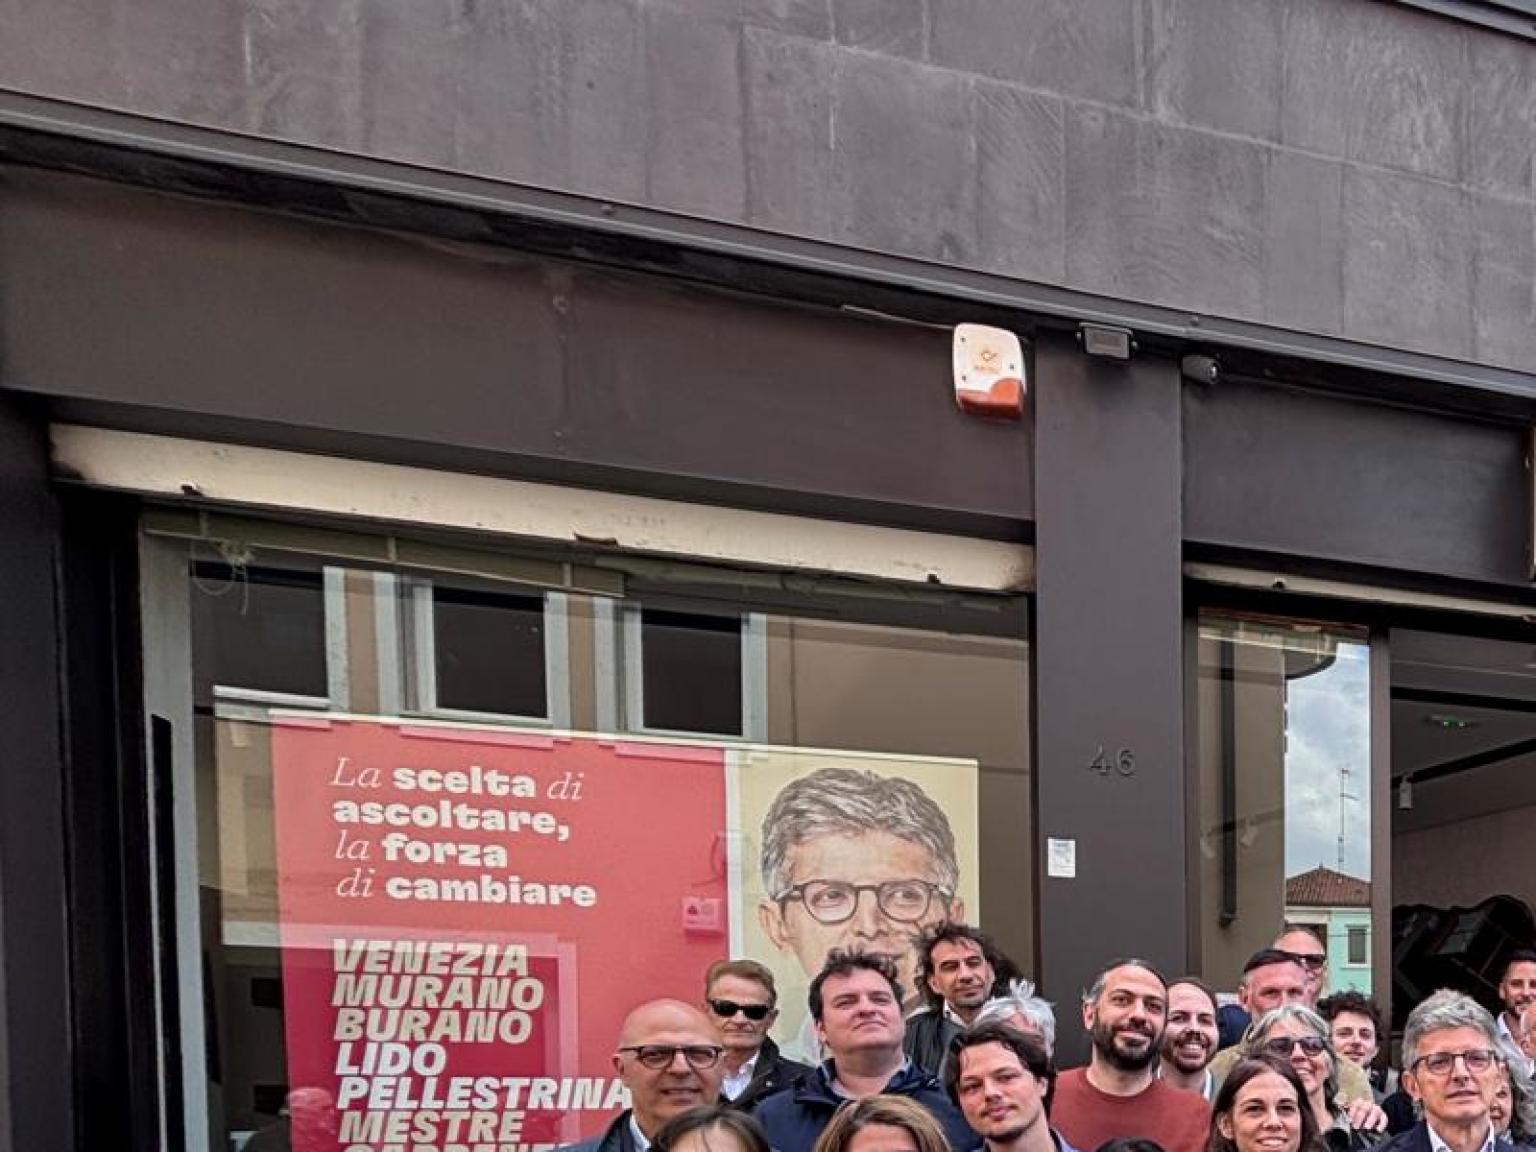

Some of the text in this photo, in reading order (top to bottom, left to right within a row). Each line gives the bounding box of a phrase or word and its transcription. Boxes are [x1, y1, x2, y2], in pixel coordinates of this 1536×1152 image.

[1087, 742, 1137, 776] 46
[328, 757, 585, 801] La scelta di
[332, 799, 570, 842] ascoltare,
[334, 829, 508, 868] la forza
[336, 868, 597, 907] di cambiare
[332, 938, 529, 976] VENEZIA
[331, 973, 544, 1011] MURANO
[334, 1007, 533, 1045] BURANO
[335, 1042, 447, 1077] LIDO
[336, 1076, 632, 1110] PELLESTRINA
[338, 1110, 525, 1144] MESTRE
